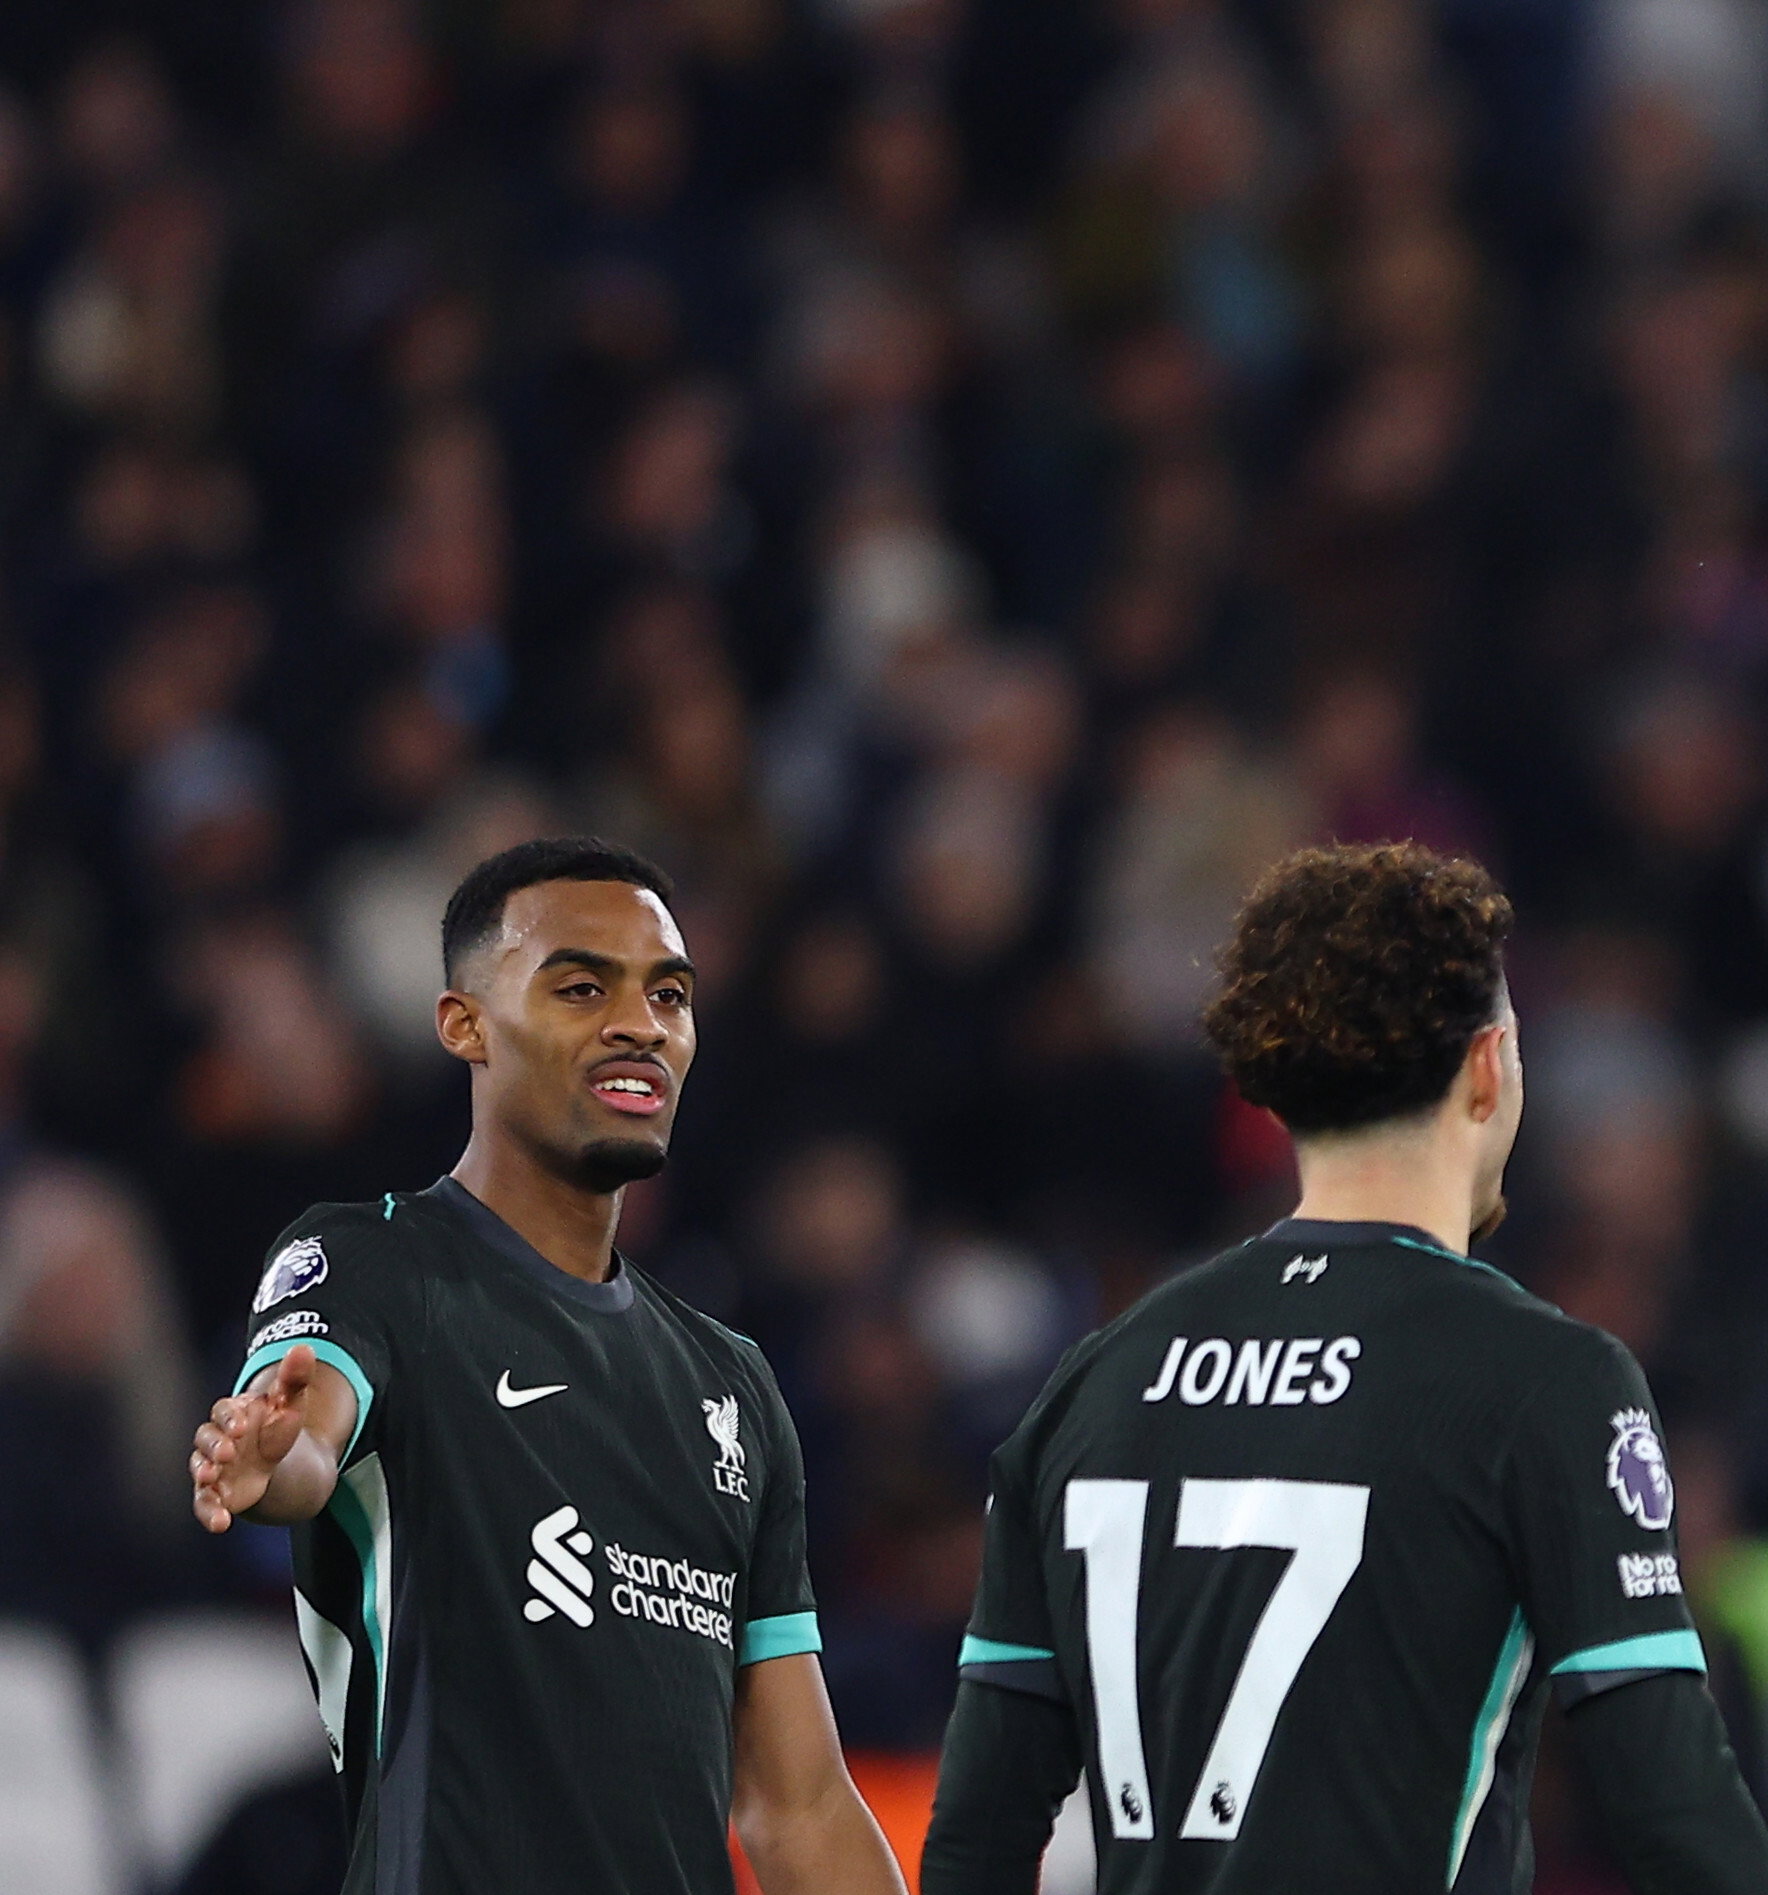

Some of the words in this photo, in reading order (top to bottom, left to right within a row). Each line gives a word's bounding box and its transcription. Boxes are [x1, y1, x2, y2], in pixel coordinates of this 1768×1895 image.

[1142, 1336, 1361, 1405] JONES
[604, 1542, 738, 1609] standard
[1617, 1553, 1654, 1577] No
[1655, 1554, 1677, 1575] ro
[1622, 1576, 1656, 1598] for
[1064, 1478, 1371, 1840] 17
